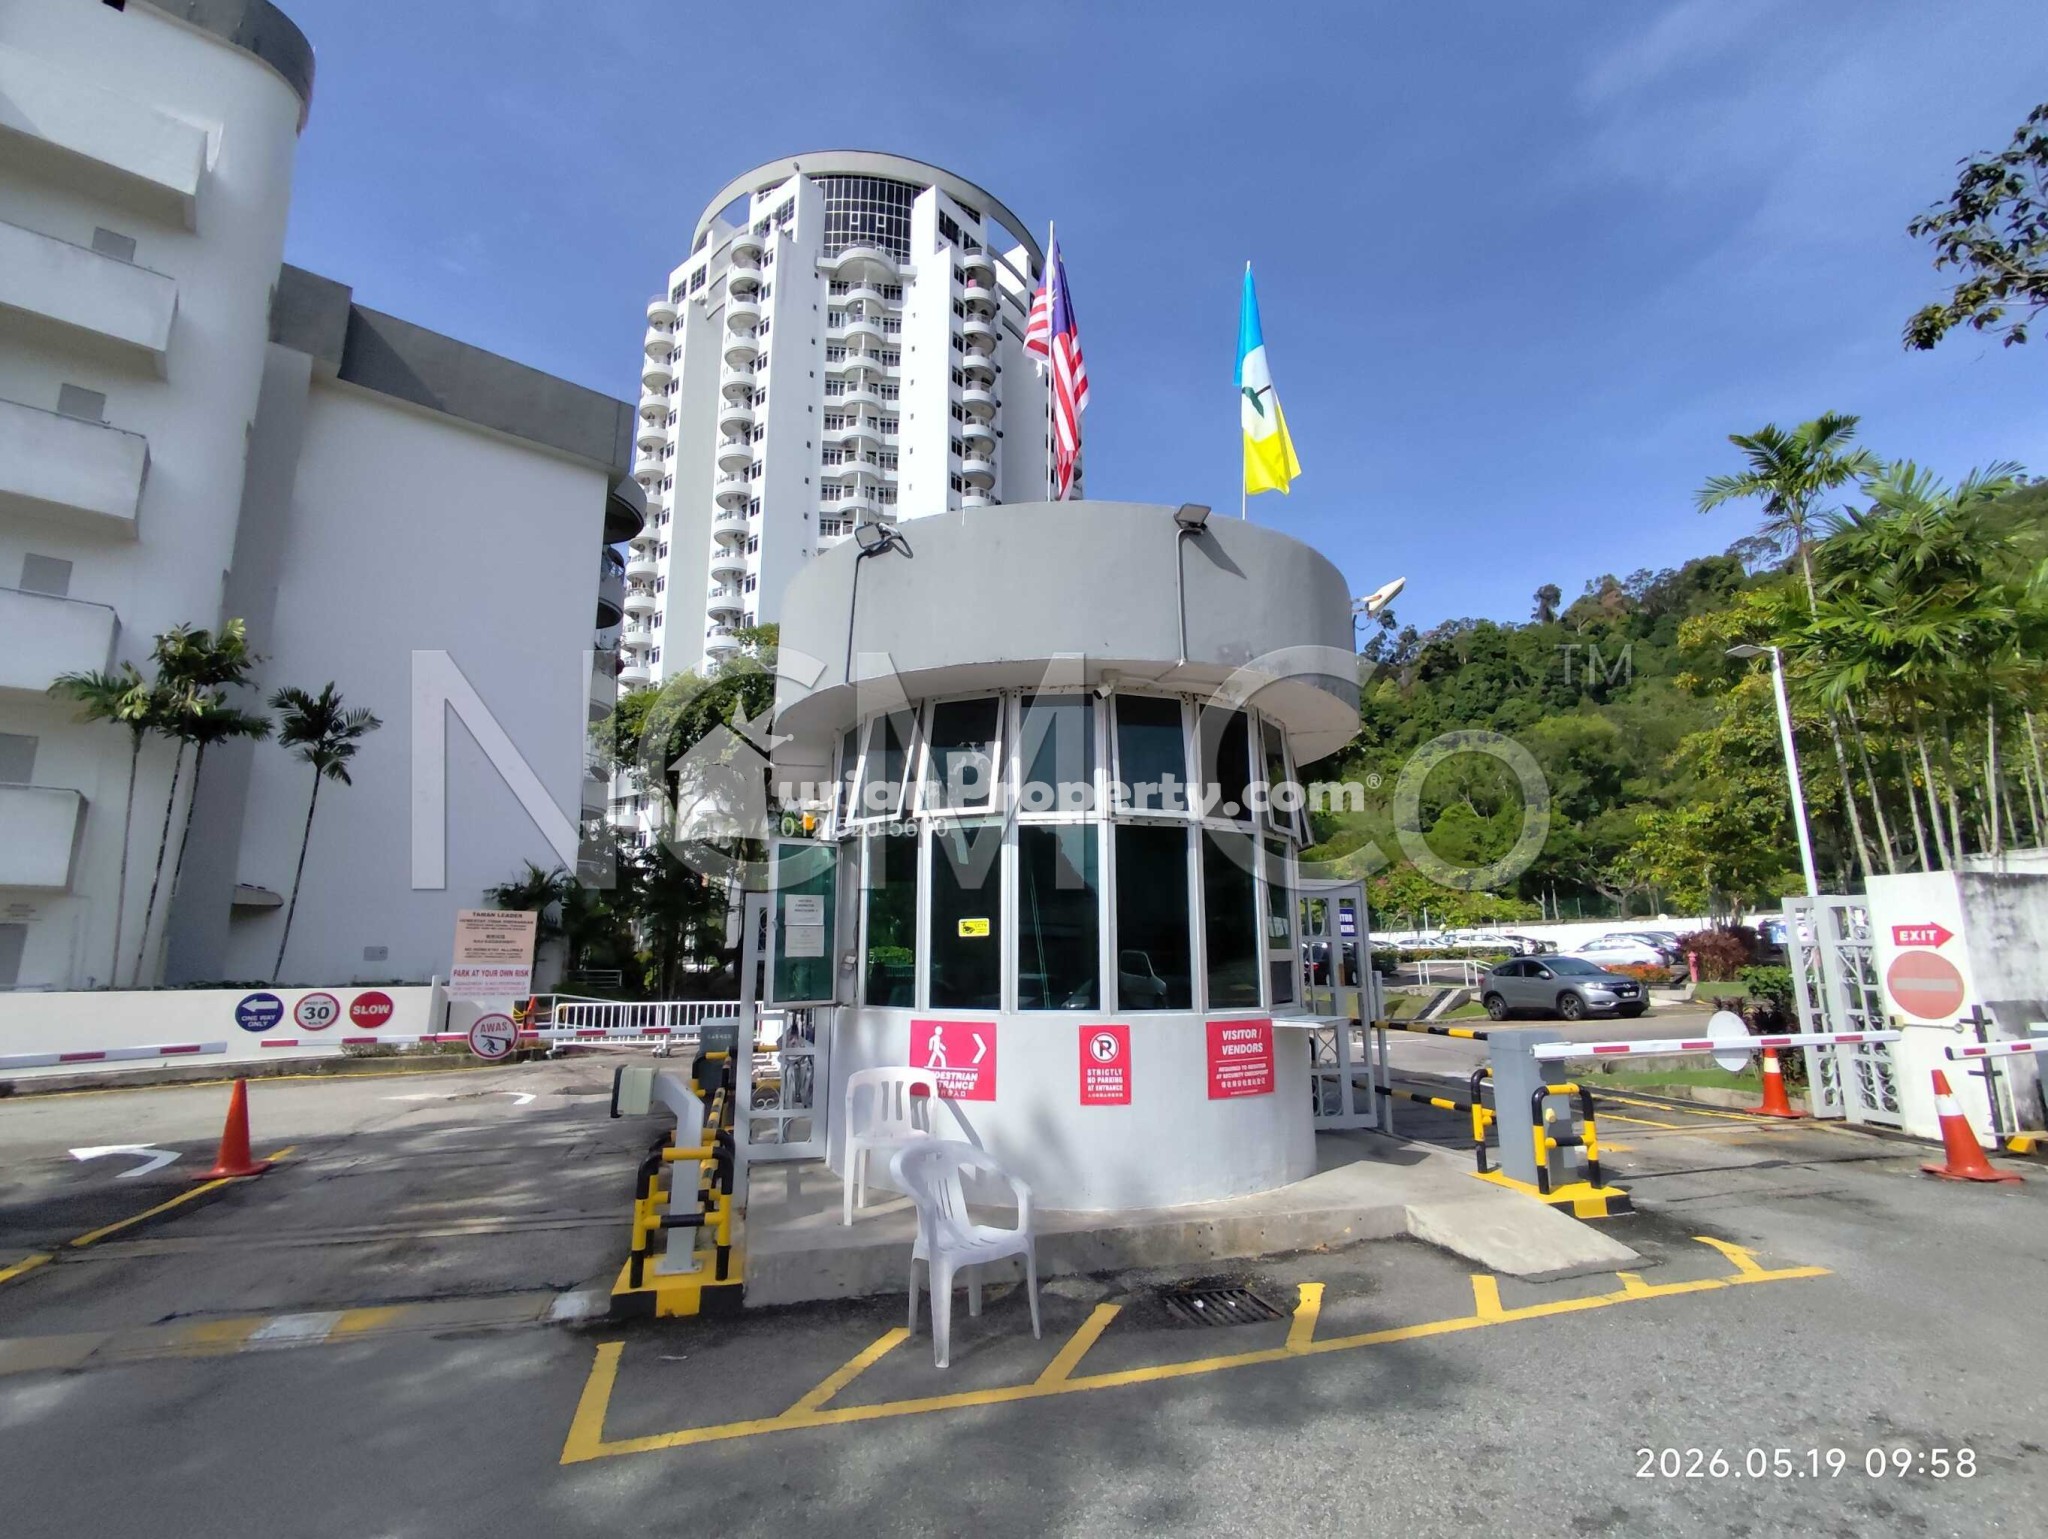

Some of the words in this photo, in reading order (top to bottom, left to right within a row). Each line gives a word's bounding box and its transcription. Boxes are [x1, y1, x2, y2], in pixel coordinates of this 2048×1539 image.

[1899, 929, 1937, 941] EXIT
[453, 969, 470, 977] PARK
[481, 969, 498, 977] YOUR
[499, 969, 513, 977] OWN
[514, 969, 529, 977] RISK
[303, 1006, 330, 1020] 30
[352, 1004, 390, 1015] SLOW
[480, 1021, 508, 1033] AWAS
[1222, 1028, 1257, 1041] VISITOR
[1221, 1042, 1263, 1056] VENDORS
[934, 1070, 979, 1082] DESTRIAN
[1087, 1068, 1123, 1076] STRICTLY
[936, 1080, 975, 1091] TRANCE
